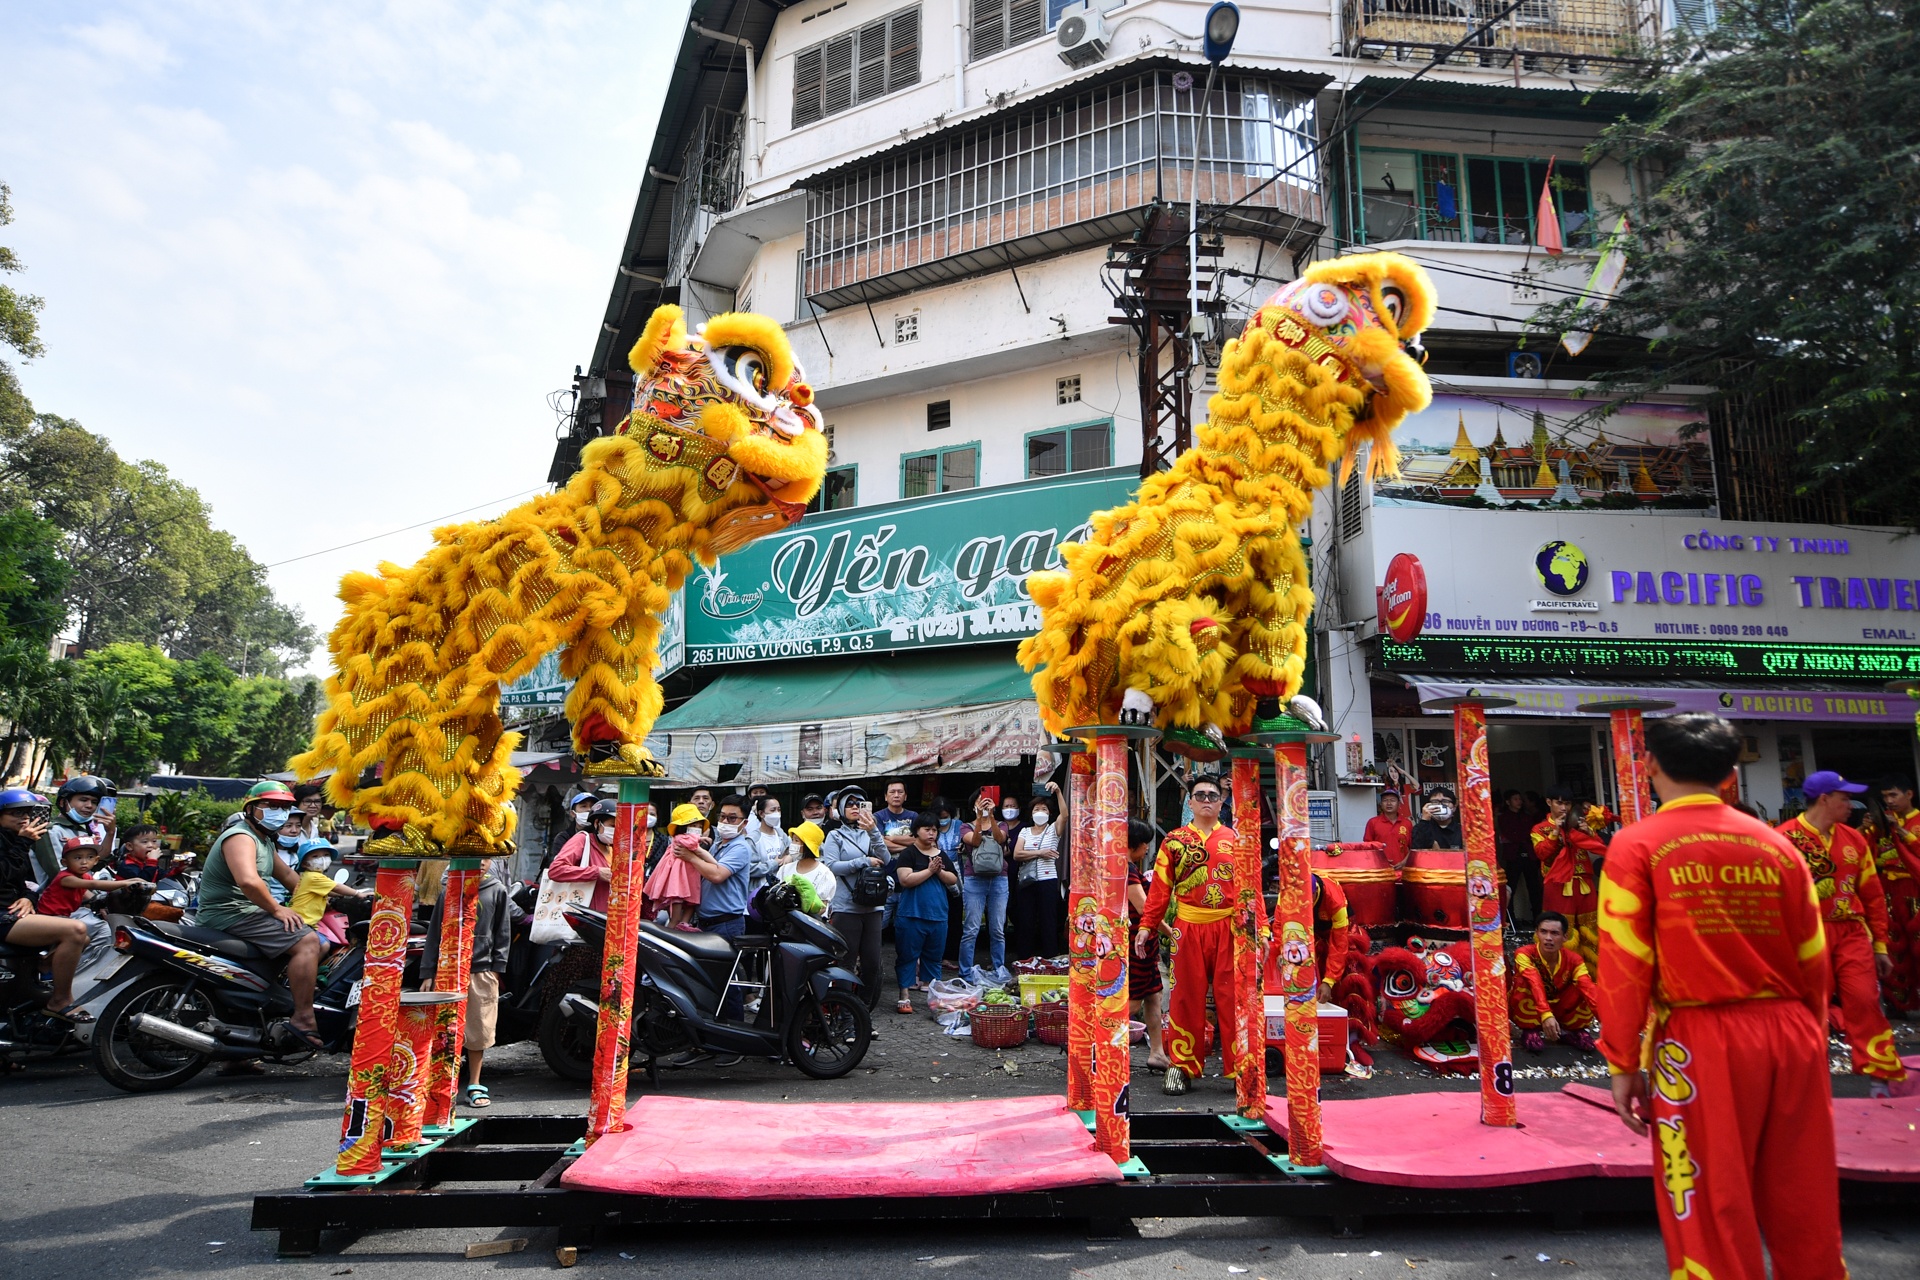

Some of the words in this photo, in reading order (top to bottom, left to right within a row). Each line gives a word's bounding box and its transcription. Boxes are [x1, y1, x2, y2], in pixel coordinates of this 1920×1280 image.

[1682, 529, 1744, 551] CÔNG
[1750, 535, 1779, 552] TY
[1788, 538, 1849, 554] TNHH
[771, 524, 936, 620] Yến
[1610, 570, 1763, 607] PACIFIC
[1536, 600, 1598, 609] PACIFICTRAVEL
[1446, 615, 1491, 631] NGUYỄN
[1495, 619, 1518, 631] DUY
[1600, 621, 1619, 634] Q.5
[1654, 622, 1701, 635] HOTLINE
[1709, 624, 1739, 635] 0909
[1862, 628, 1917, 641] EMAIL:
[692, 648, 714, 664] 265
[821, 637, 845, 653] P.9,
[849, 634, 874, 652] Q.5
[1463, 646, 1492, 662] MY
[1762, 652, 1799, 673] QUY
[1802, 653, 1856, 670] NHON
[1858, 654, 1902, 672] 3N2D
[1741, 695, 1813, 713] PACIFIC
[1824, 698, 1888, 715] TRAVEL
[1493, 1061, 1514, 1097] 8
